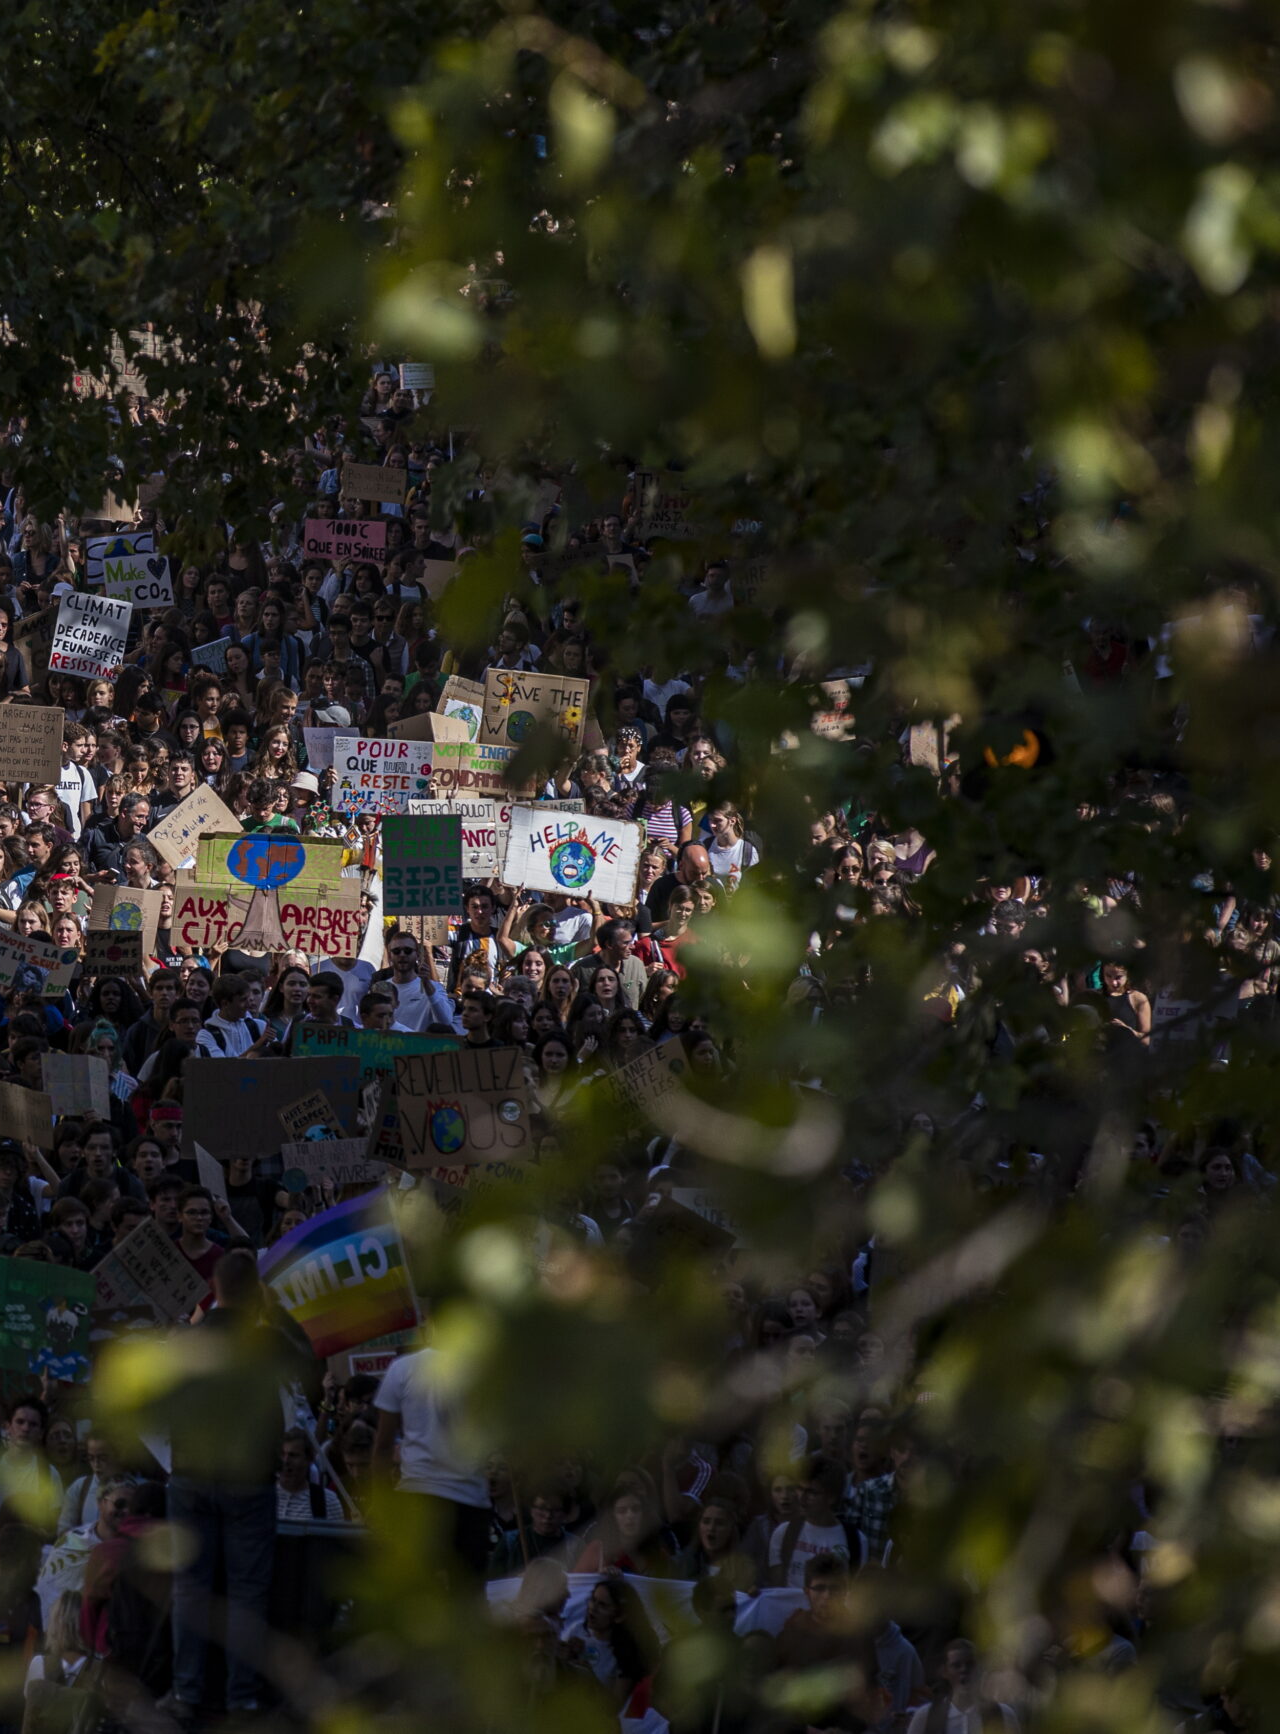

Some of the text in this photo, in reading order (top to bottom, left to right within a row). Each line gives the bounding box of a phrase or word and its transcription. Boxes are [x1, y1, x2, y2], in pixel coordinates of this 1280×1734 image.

[307, 538, 332, 554] QUE
[336, 542, 352, 556] EN
[105, 559, 146, 583] Make
[66, 594, 127, 619] CLIMAT
[81, 613, 100, 628] EN
[56, 623, 126, 653] DECADENCE
[53, 638, 110, 663] JEUNESSE
[492, 673, 541, 702] SAVE
[550, 688, 583, 708] THE
[357, 740, 409, 759] POUR
[435, 742, 478, 759] VOTRE
[7, 770, 40, 779] RESPIRER
[346, 756, 378, 774] QUE
[360, 773, 410, 790] RESTE
[454, 802, 493, 819] BOULOT
[385, 817, 460, 839] PLANT
[383, 839, 460, 859] TREES
[529, 820, 623, 864] HELP ME
[385, 865, 460, 887] RIDE
[385, 884, 460, 909] BIKES
[177, 896, 360, 936] AUX ARBRES
[11, 950, 27, 964] LA
[42, 946, 59, 959] LA
[302, 1026, 349, 1048] PAPA
[394, 1047, 522, 1097] REVEILLEZ
[331, 1163, 371, 1183] VIVRE
